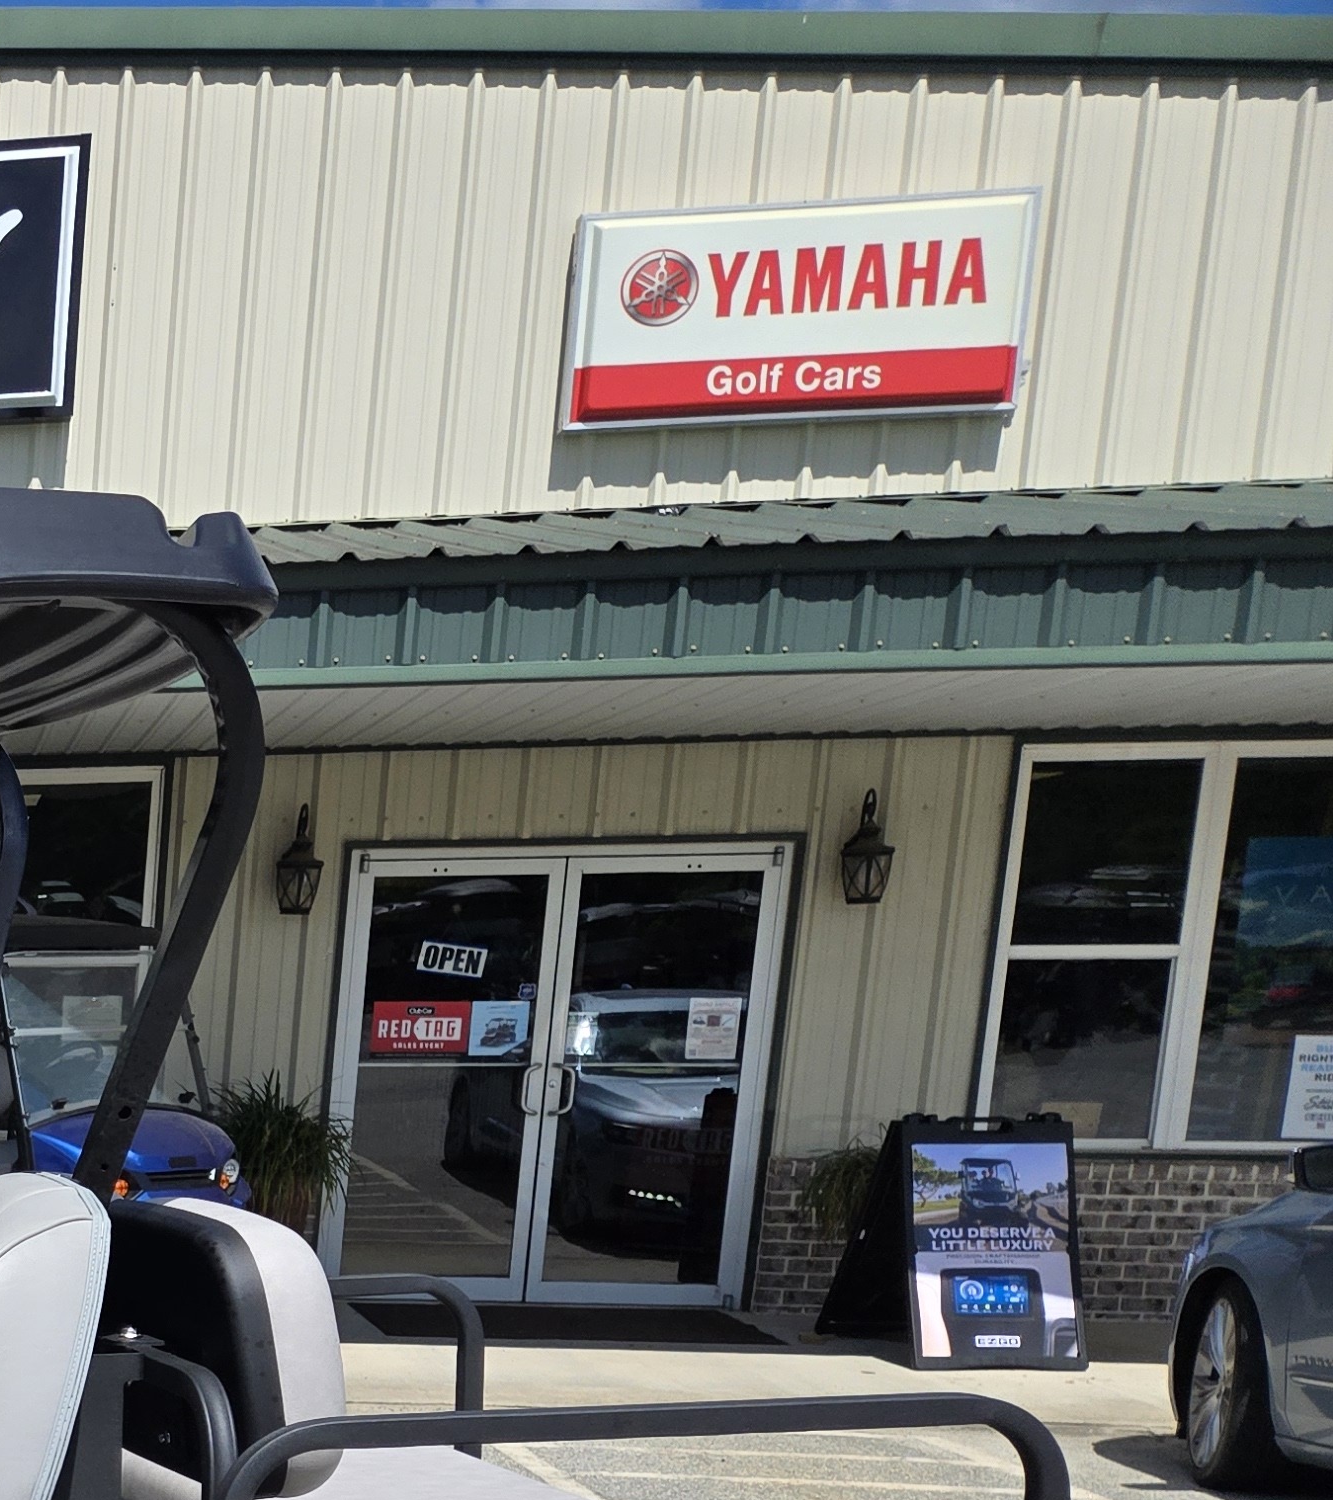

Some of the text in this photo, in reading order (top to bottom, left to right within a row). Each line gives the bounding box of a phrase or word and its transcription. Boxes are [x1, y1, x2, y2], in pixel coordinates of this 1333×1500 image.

[707, 237, 988, 318] YAMAHA
[706, 360, 883, 397] Golf Cars
[422, 945, 483, 975] OPEN
[377, 1019, 457, 1038] RED TAG
[928, 1226, 1056, 1239] YOU DESERVE A
[931, 1239, 1054, 1251] LITTLE LUXURY
